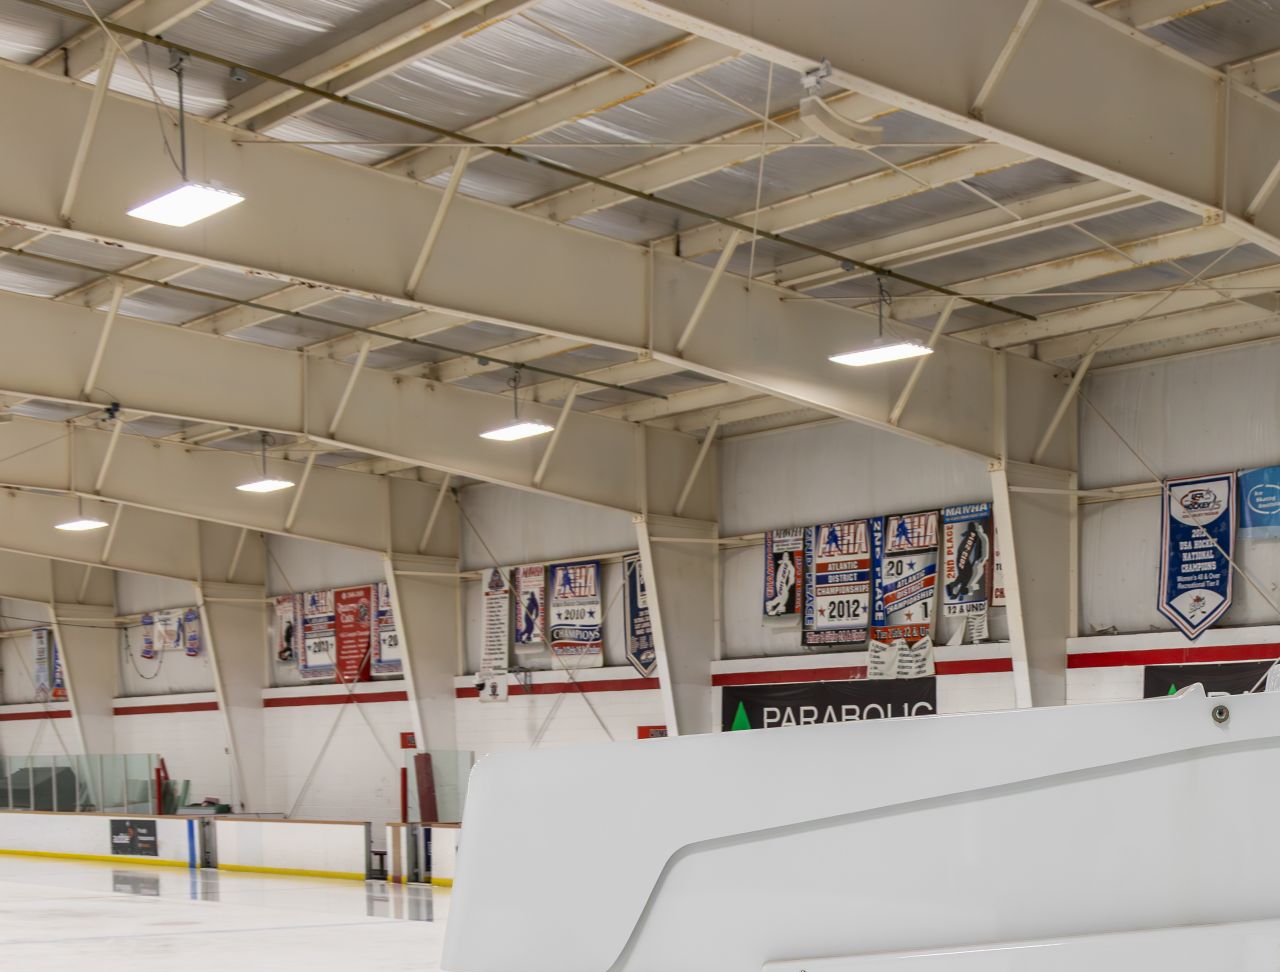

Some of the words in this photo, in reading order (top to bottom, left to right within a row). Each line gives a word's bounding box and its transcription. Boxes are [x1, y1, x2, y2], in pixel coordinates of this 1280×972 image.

[946, 524, 955, 558] PLACE
[1182, 550, 1215, 561] NATIONAL
[828, 561, 858, 571] ATLANTIC
[886, 560, 903, 577] 20
[946, 559, 956, 579] 2ND
[1181, 561, 1217, 573] CHAMPIONS
[828, 573, 858, 583] DISTRICT
[896, 570, 925, 588] ATLANTIC
[817, 585, 869, 596] CHAMPIONSHIPS
[896, 581, 924, 599] DISTRICT
[564, 608, 586, 620] 2010
[829, 599, 860, 618] 2012
[553, 627, 601, 641] CHAMPIONS
